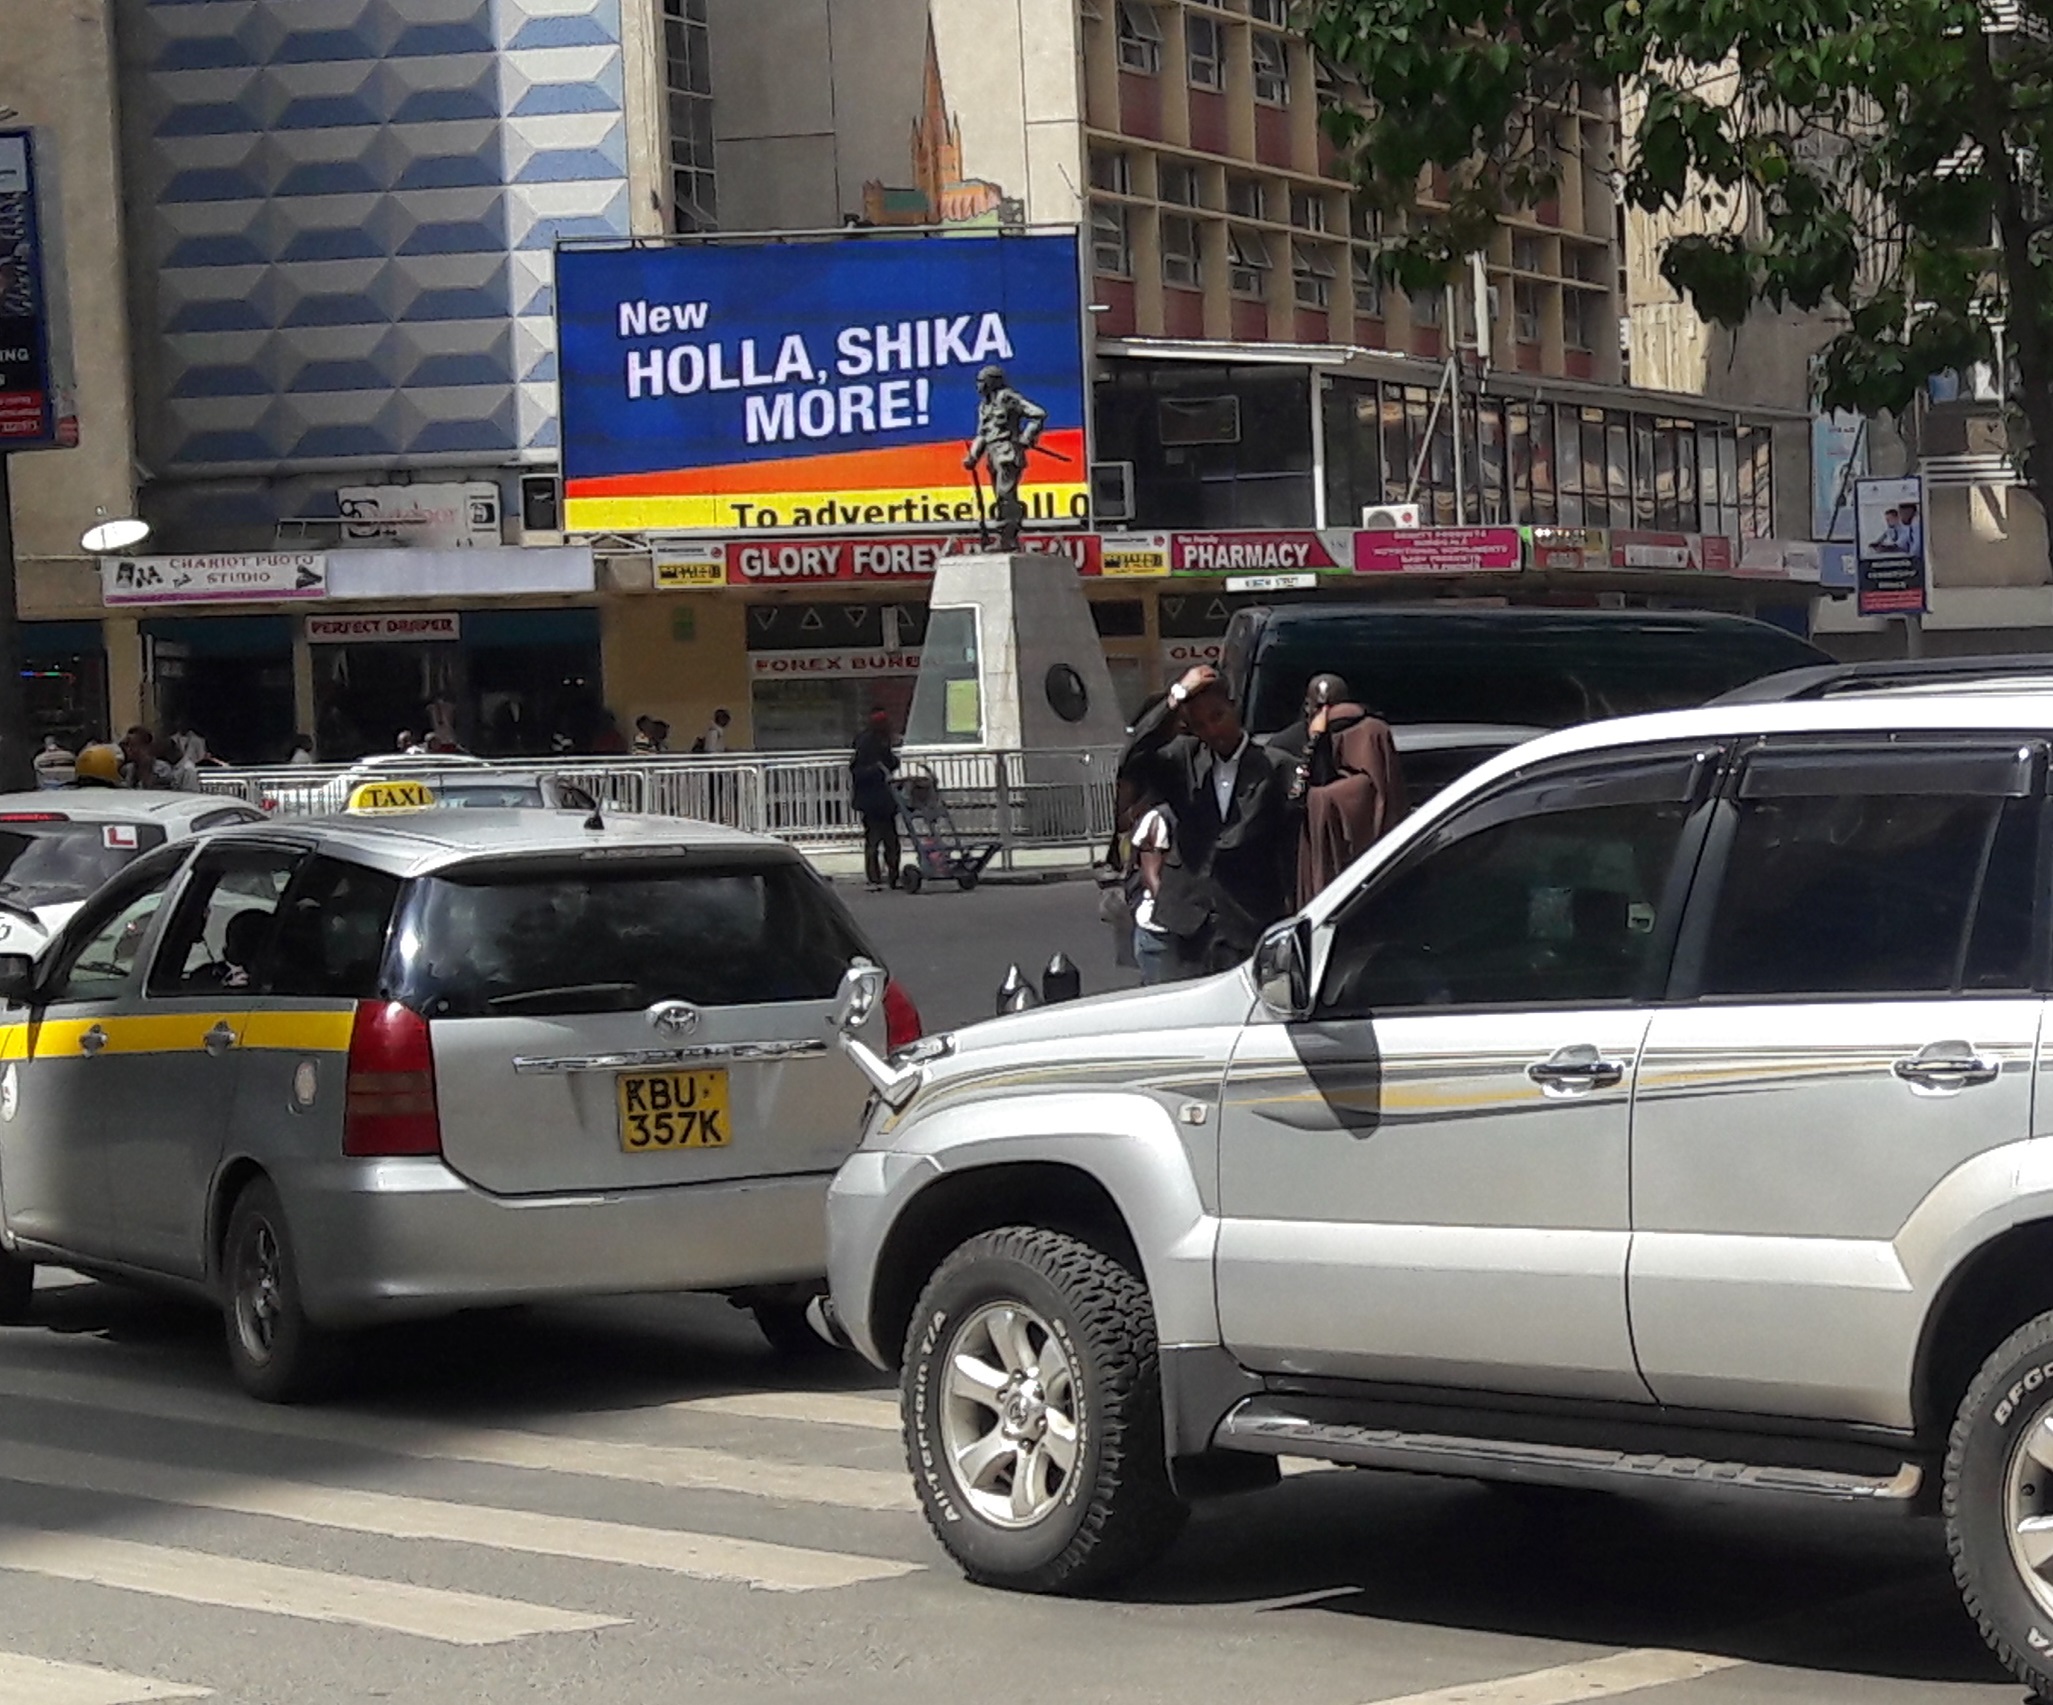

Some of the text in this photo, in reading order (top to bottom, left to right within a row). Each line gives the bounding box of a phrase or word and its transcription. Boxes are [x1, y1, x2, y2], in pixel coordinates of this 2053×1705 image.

[620, 301, 708, 336] New
[627, 312, 1013, 399] HOLLA, SHIKA
[746, 378, 929, 443] MORE!
[731, 504, 778, 528] To
[792, 496, 973, 526] advertise
[740, 545, 842, 577] GLORY
[853, 538, 950, 574] FOREX
[1184, 543, 1309, 569] PHARMACY
[755, 656, 842, 671] FOREX
[366, 786, 425, 807] TAXI
[626, 1077, 696, 1112] KBU
[628, 1110, 722, 1147] 357K
